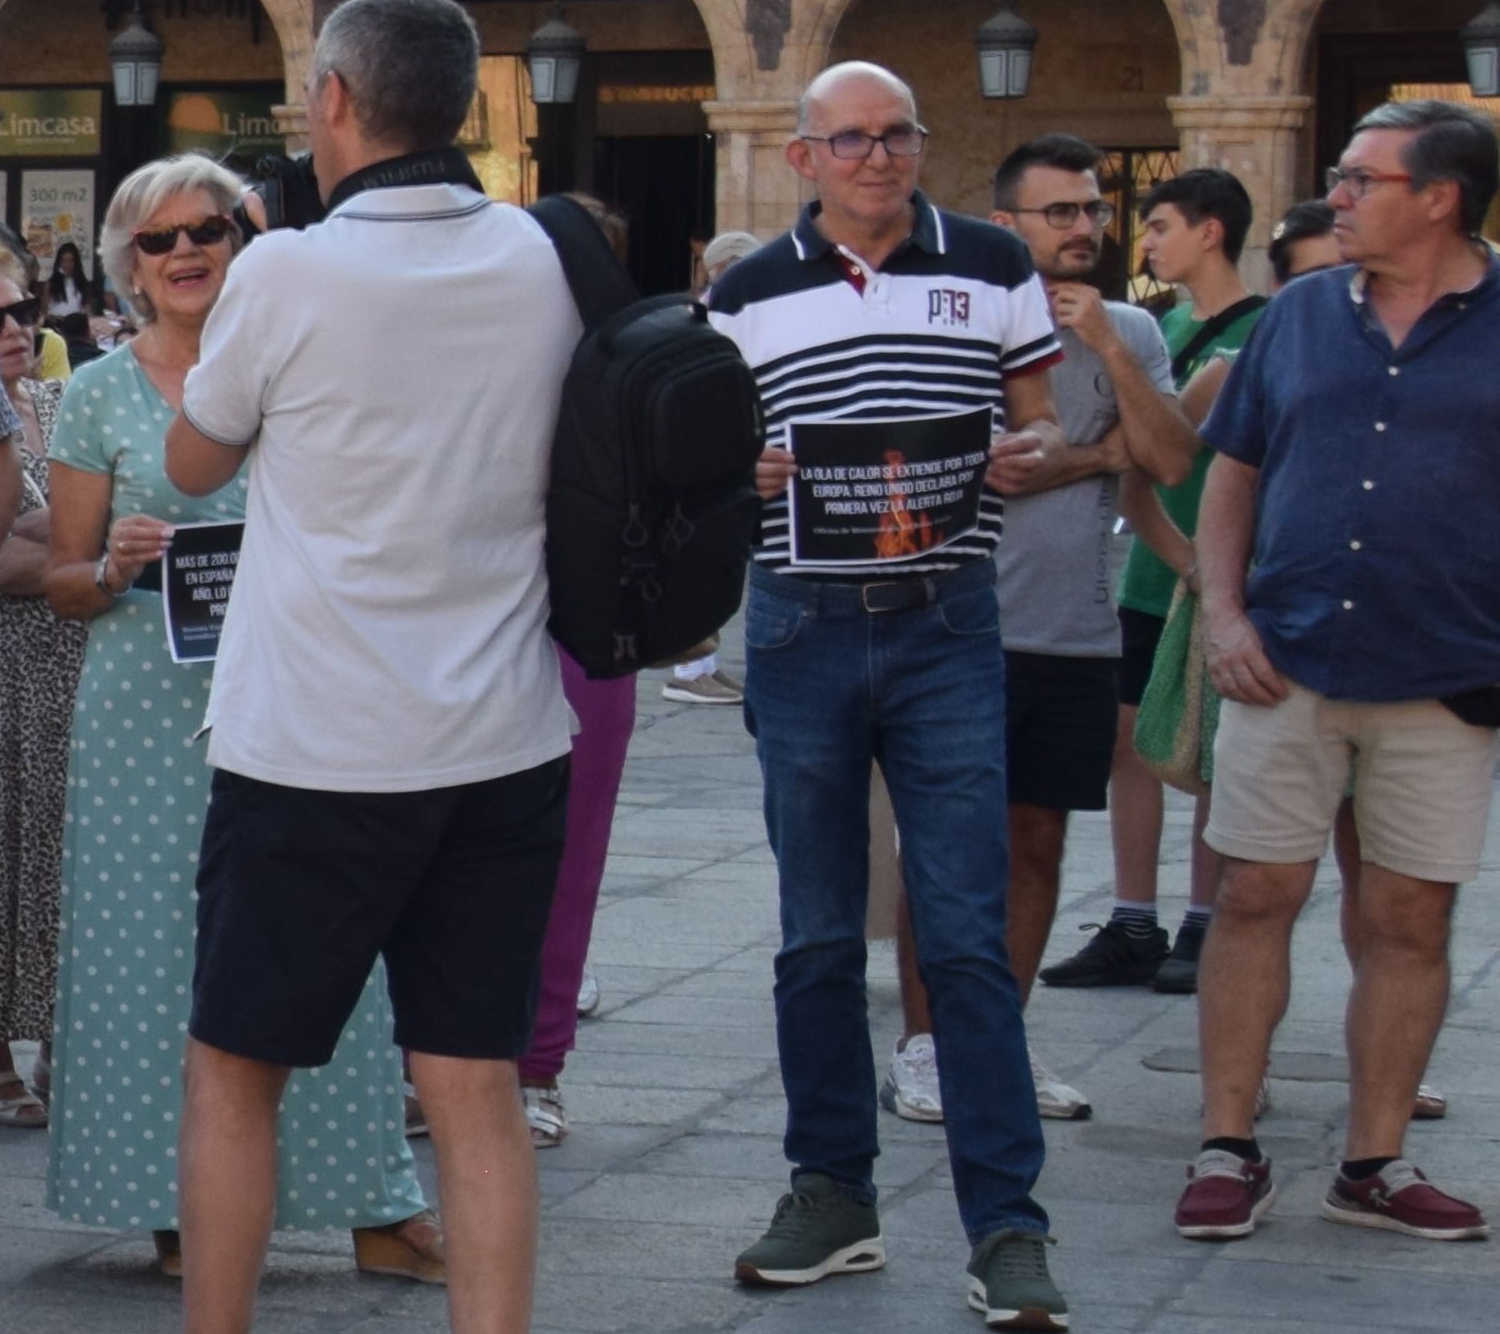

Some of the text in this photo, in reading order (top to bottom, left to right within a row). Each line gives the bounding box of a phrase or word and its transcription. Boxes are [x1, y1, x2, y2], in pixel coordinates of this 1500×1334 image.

[800, 467, 813, 481] LA
[814, 466, 833, 481] OLA
[834, 466, 847, 480] DE
[848, 465, 882, 480] CALOR
[825, 500, 869, 516] PRIMERA
[870, 500, 890, 514] VEZ
[906, 494, 943, 511] ALERTA
[175, 555, 196, 569] MÁS
[197, 554, 209, 568] DE
[185, 573, 198, 586] EN
[214, 586, 226, 600] LO
[209, 602, 228, 617] PRO
